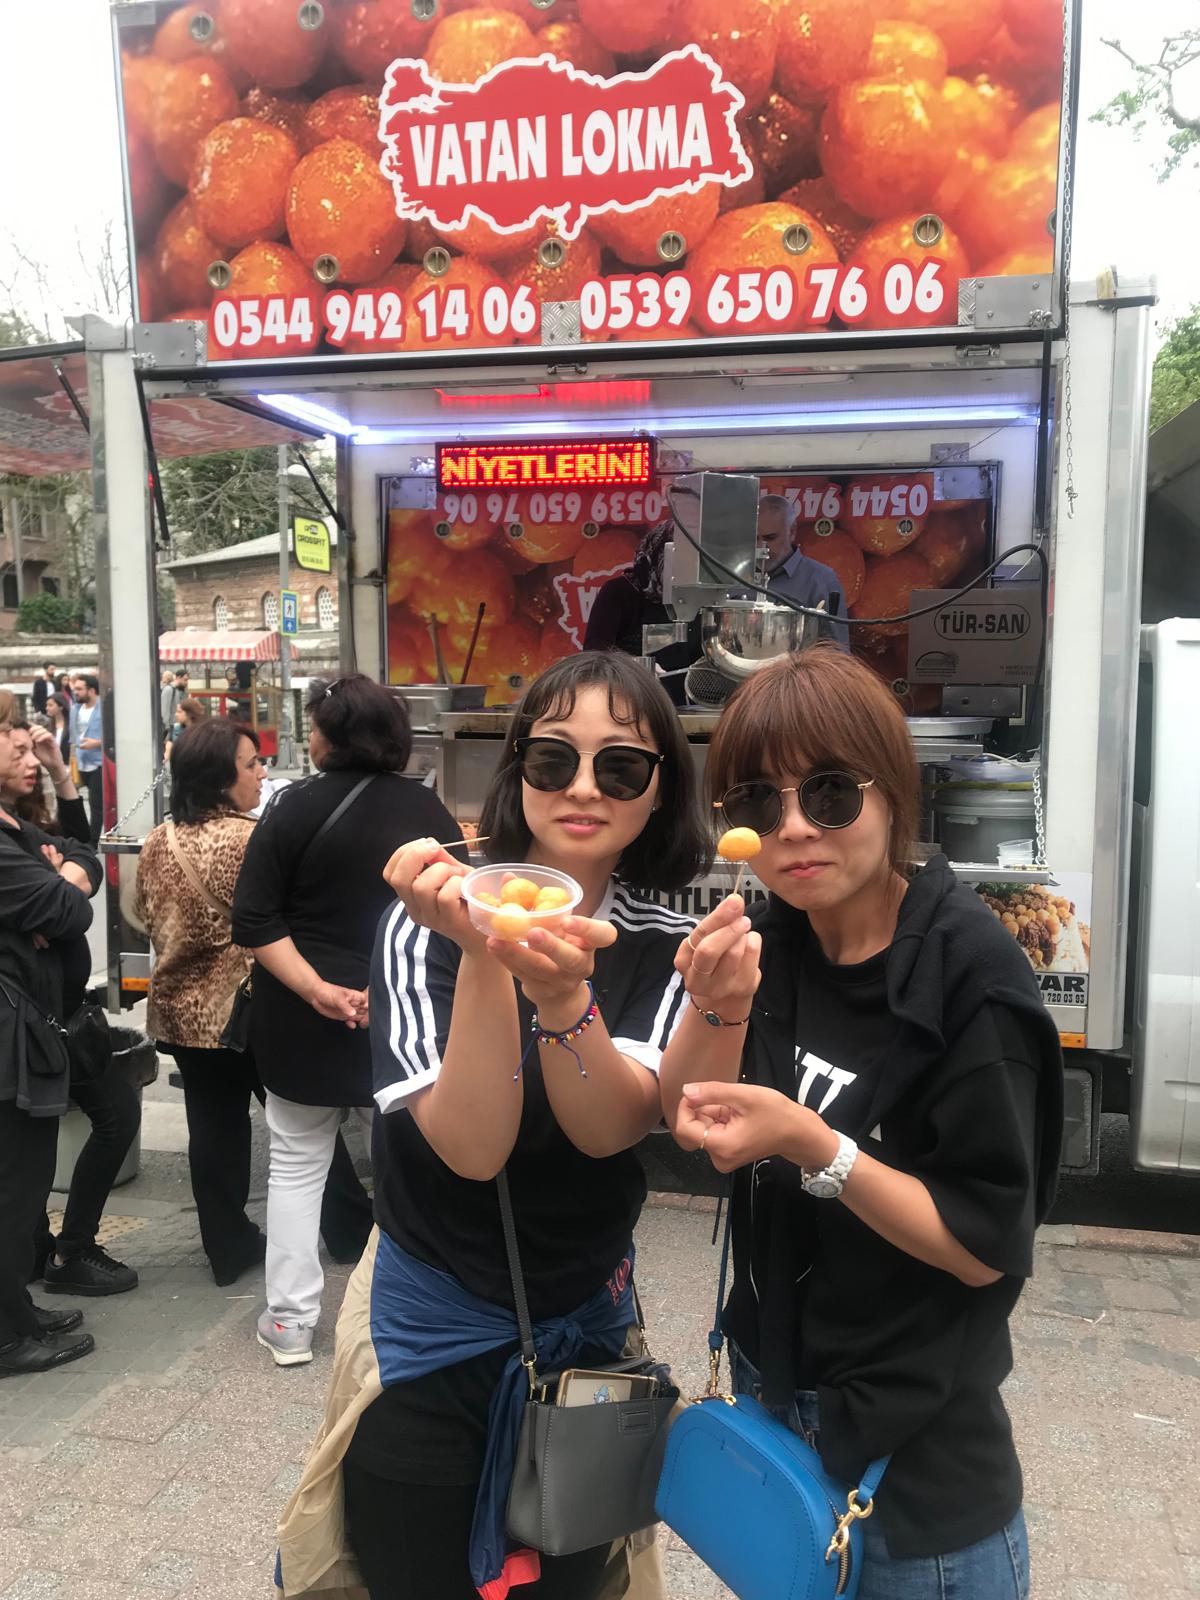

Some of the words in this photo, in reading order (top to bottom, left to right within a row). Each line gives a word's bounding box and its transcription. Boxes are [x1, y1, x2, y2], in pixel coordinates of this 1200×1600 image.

[409, 115, 547, 187] VATAN
[561, 103, 713, 176] LOKMA
[580, 276, 692, 330] 0539
[707, 271, 793, 324] 650
[809, 267, 867, 318] 76
[884, 262, 944, 315] 06
[214, 297, 313, 347] 0544
[326, 293, 402, 341] 942
[418, 289, 469, 337] 14
[482, 285, 536, 335] 06
[442, 443, 643, 480] NİYETLERİNİ
[444, 493, 478, 524] 06
[486, 493, 521, 523] 76
[529, 492, 581, 523] 650
[591, 490, 662, 524] 0539
[851, 484, 928, 517] 0544
[941, 611, 1025, 634] TÜR-SAN
